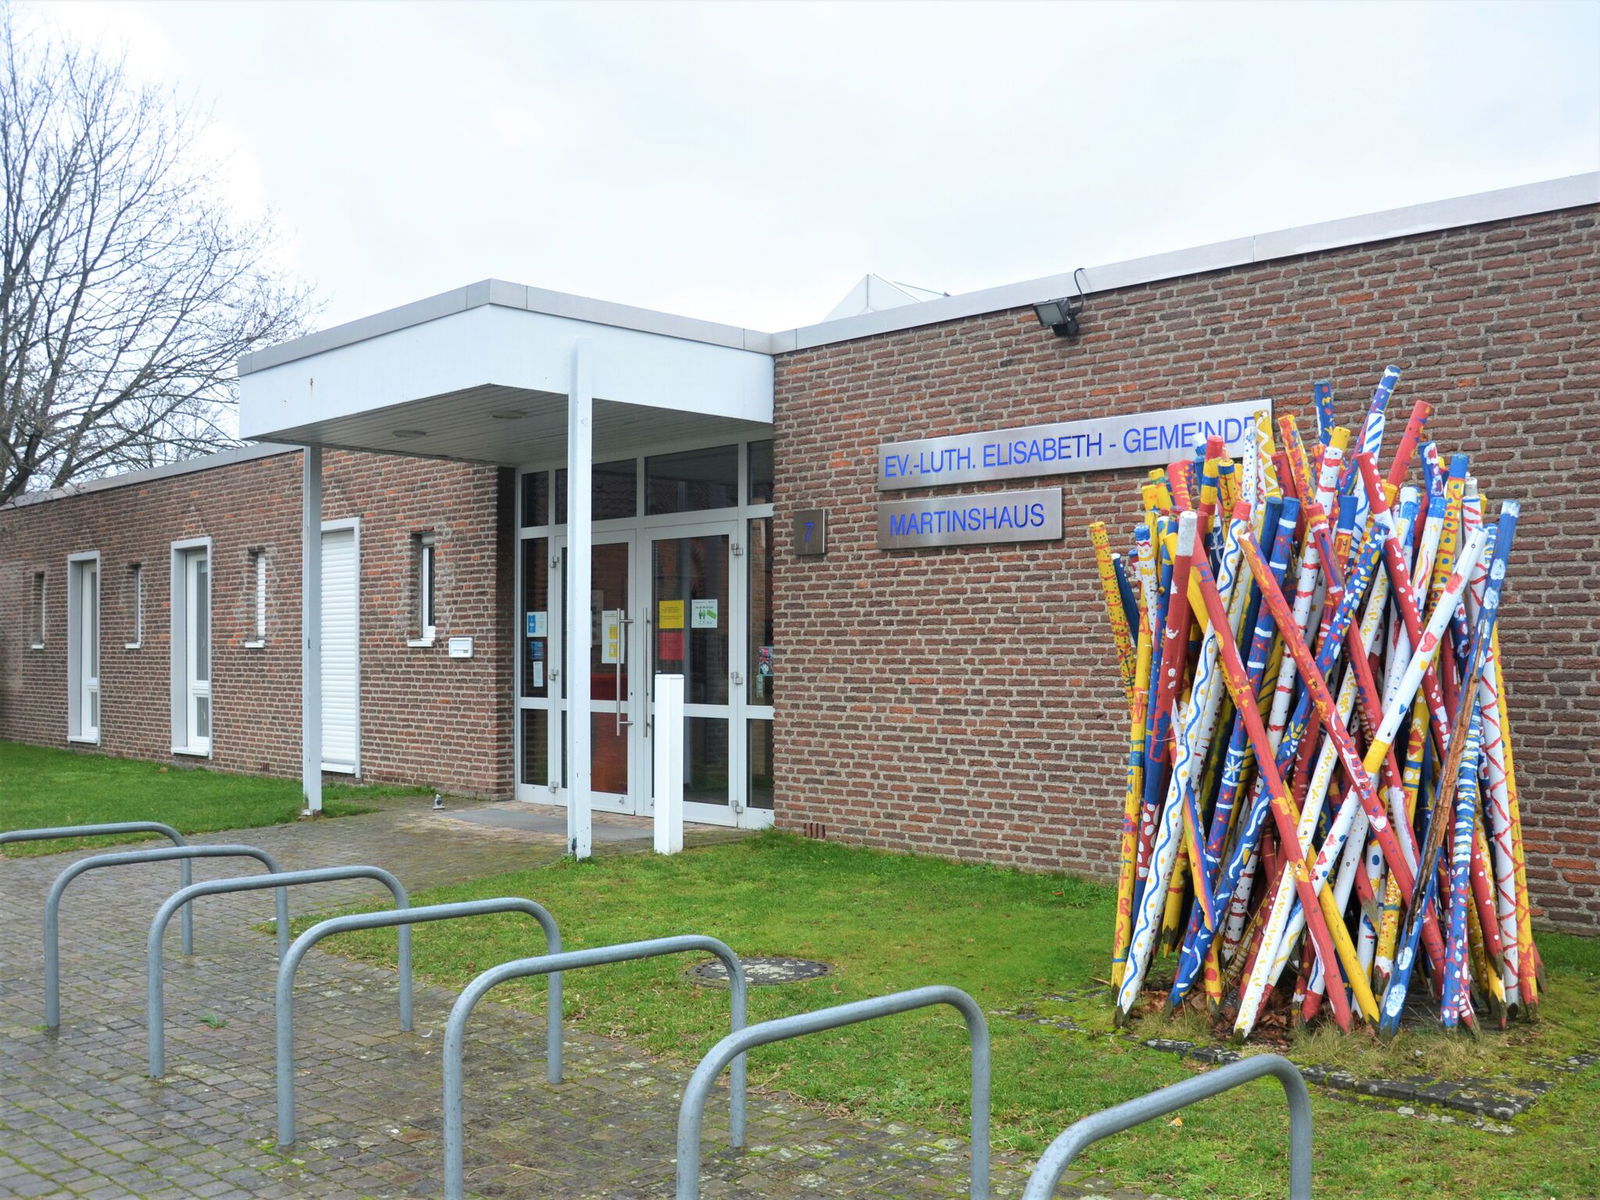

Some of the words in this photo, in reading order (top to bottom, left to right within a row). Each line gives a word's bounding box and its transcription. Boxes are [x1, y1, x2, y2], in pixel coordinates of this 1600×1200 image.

[884, 446, 976, 478] EV.-LUTH.
[982, 432, 1102, 468] ELISABETH
[801, 521, 815, 543] 7
[889, 503, 1046, 536] MARTINSHAUS
